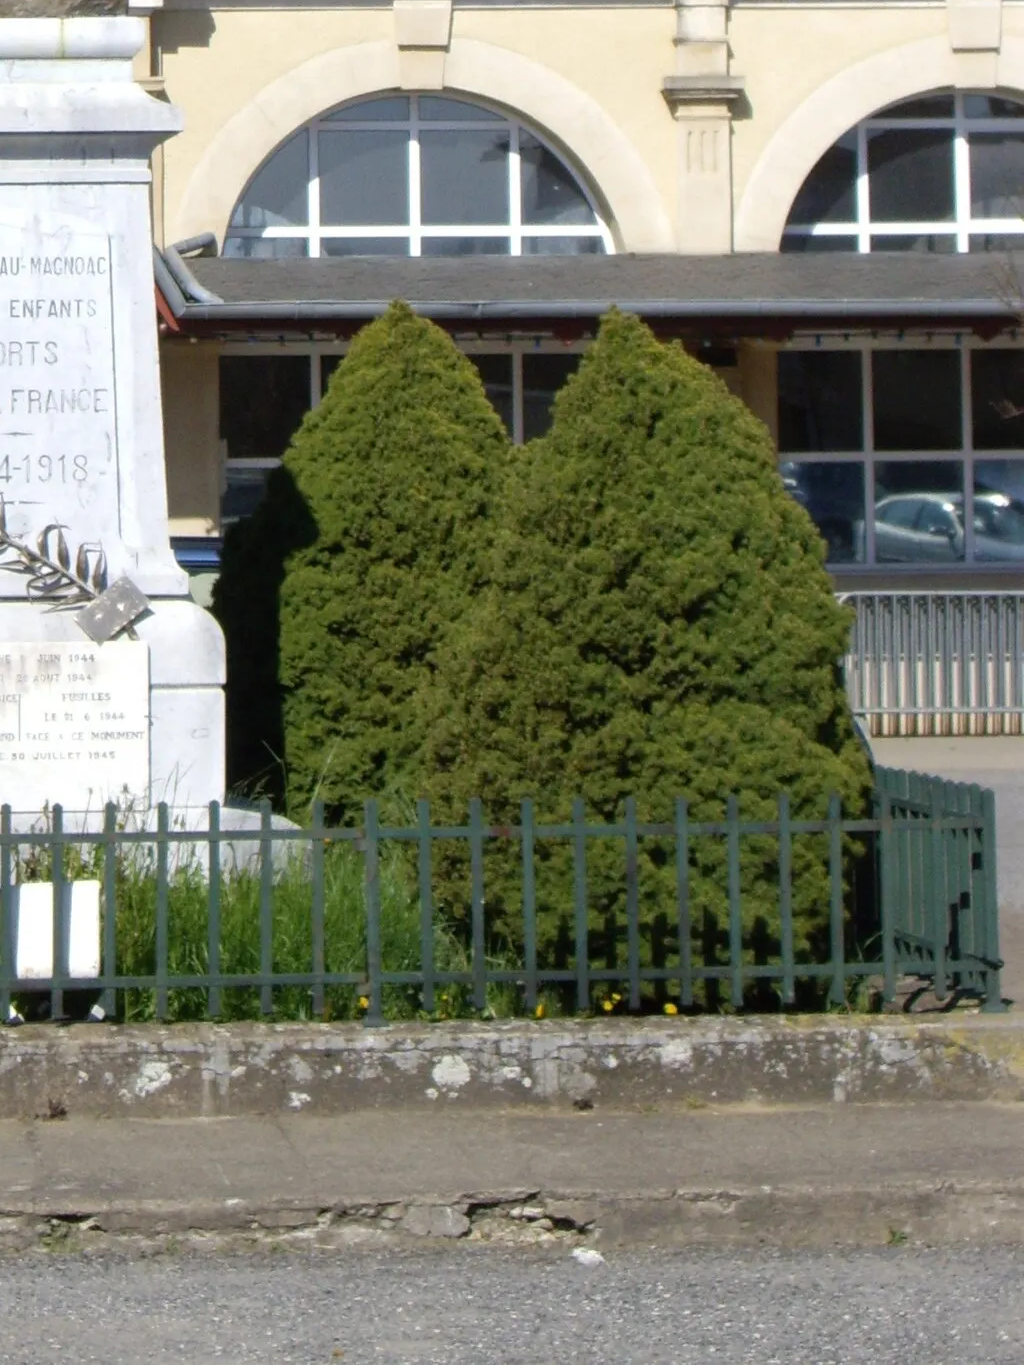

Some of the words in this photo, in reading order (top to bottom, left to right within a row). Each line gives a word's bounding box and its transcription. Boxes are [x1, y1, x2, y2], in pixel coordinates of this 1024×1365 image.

[9, 299, 97, 319] ENFANTS
[10, 389, 108, 414] FRANCE
[37, 653, 61, 663] JUIN
[68, 653, 96, 663] 1944
[67, 673, 94, 683] 1944
[43, 713, 57, 722] LE
[100, 712, 125, 721] 1944
[90, 731, 145, 741] MONUMENT
[32, 751, 82, 761] JUILLET
